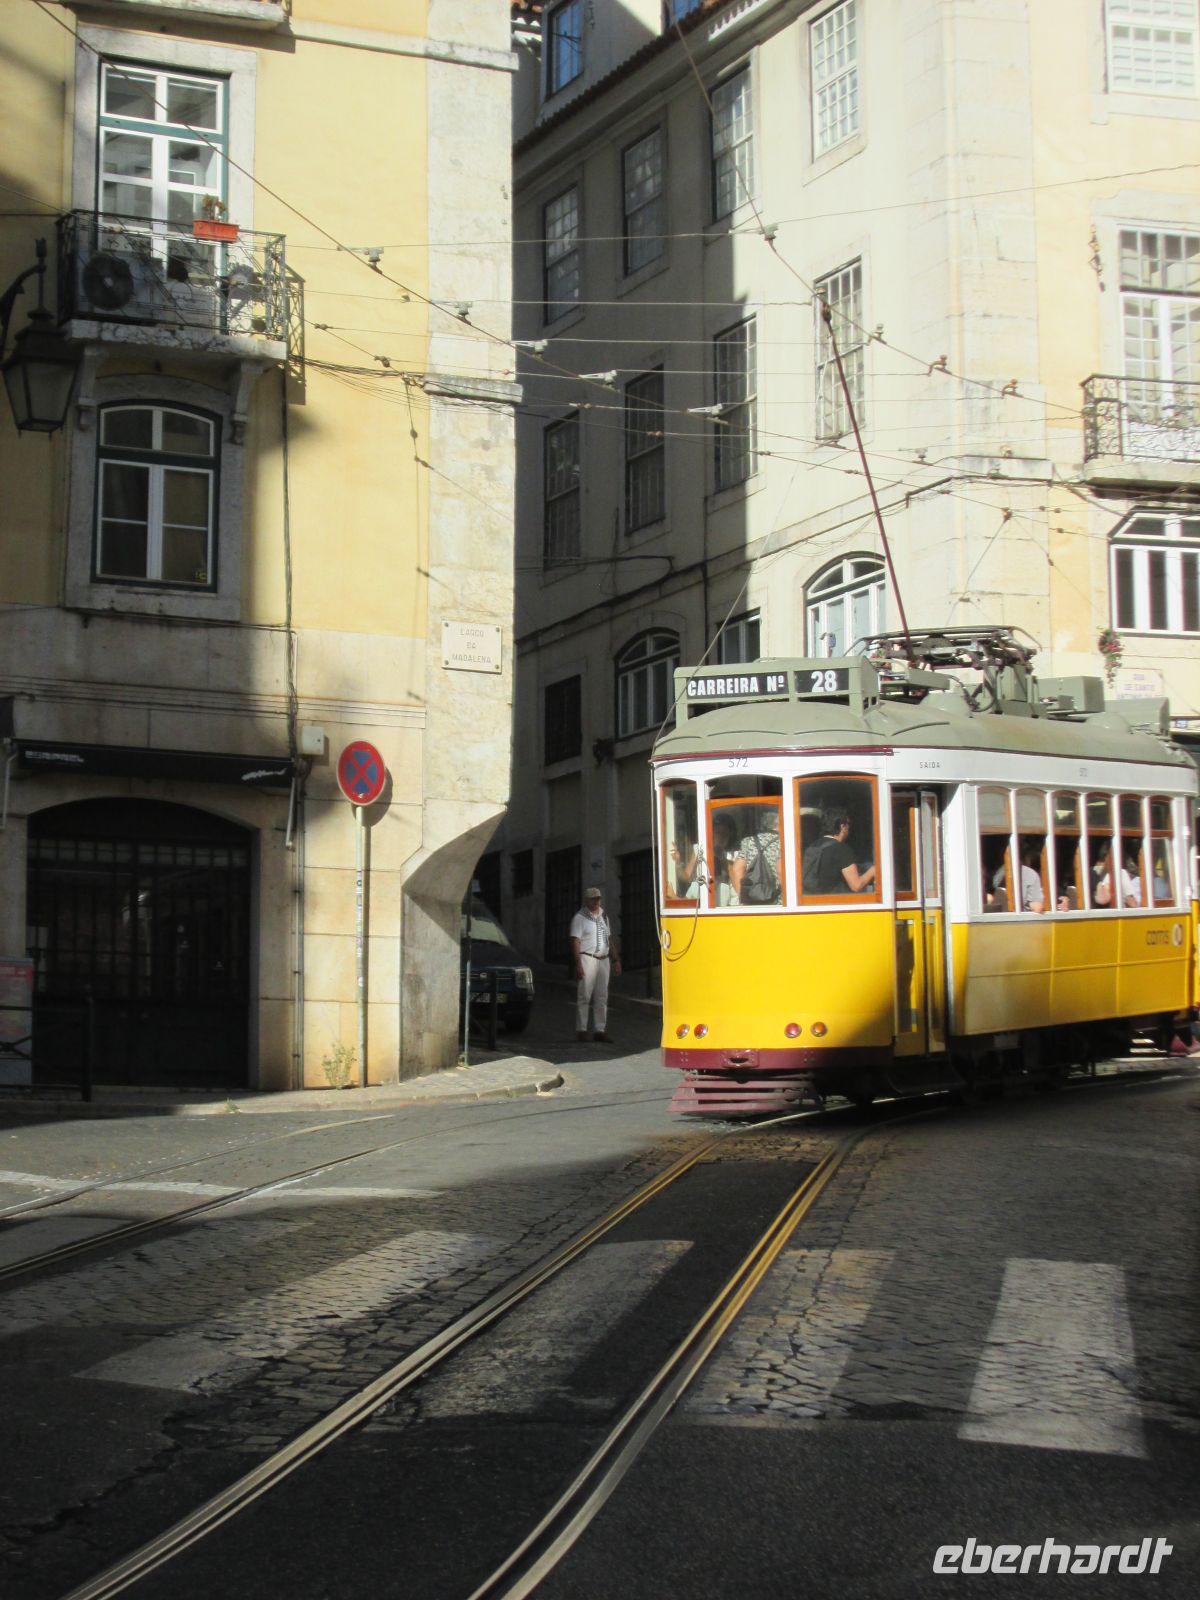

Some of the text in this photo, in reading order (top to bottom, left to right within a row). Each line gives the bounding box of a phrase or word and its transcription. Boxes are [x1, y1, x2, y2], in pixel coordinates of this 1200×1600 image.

[452, 653, 491, 663] MADALENA
[687, 676, 759, 697] CARREIRA
[810, 670, 838, 693] 28
[728, 757, 748, 768] 572
